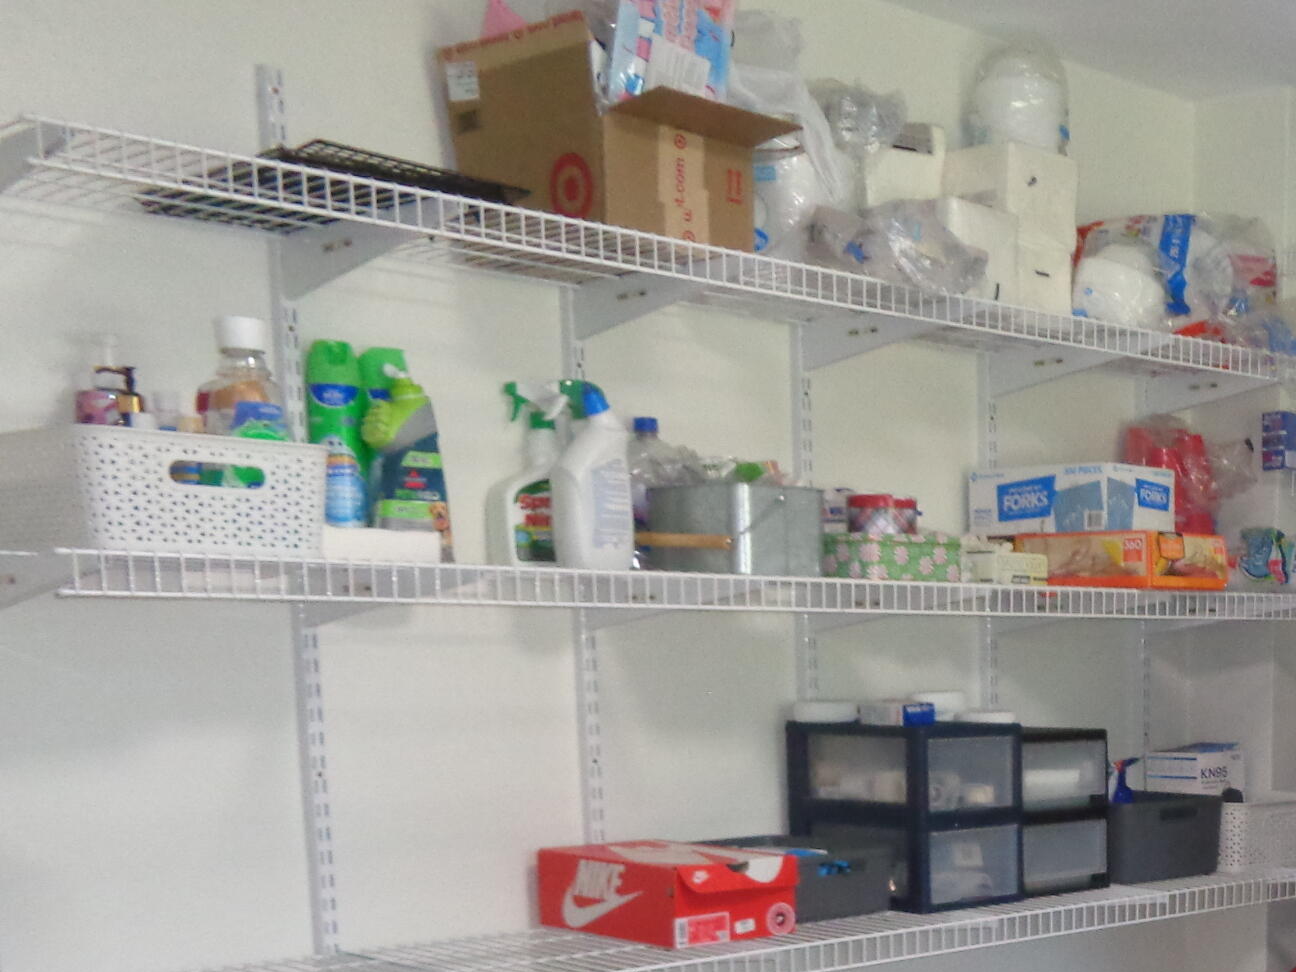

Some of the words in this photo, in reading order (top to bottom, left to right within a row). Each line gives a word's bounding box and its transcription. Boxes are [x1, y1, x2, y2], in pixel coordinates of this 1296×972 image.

[1003, 491, 1048, 511] FORKS
[1200, 766, 1228, 779] KN95
[573, 859, 626, 900] NIKE
